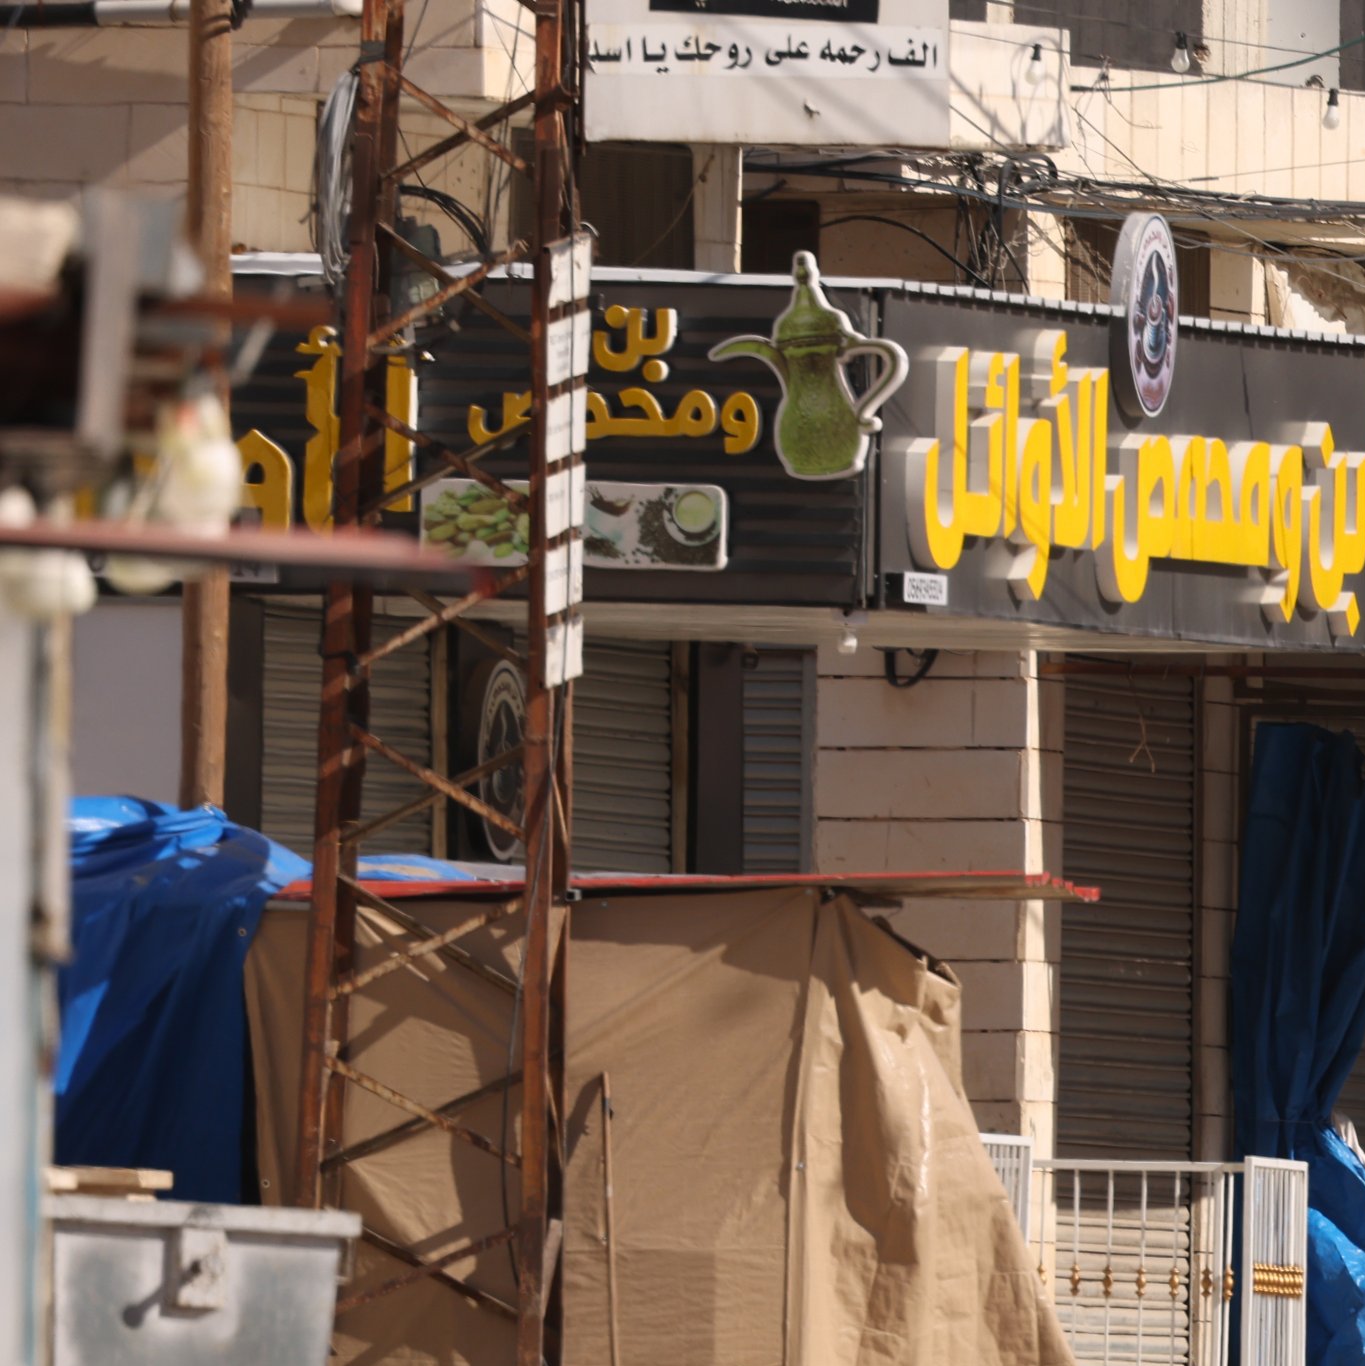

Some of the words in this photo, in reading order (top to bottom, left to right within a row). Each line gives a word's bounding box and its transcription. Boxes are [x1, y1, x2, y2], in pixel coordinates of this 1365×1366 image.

[641, 36, 668, 74] يا
[674, 36, 752, 70] روحك
[764, 34, 810, 67] على
[818, 37, 882, 72] رحمه
[887, 38, 939, 68] الف
[593, 303, 678, 384] بن
